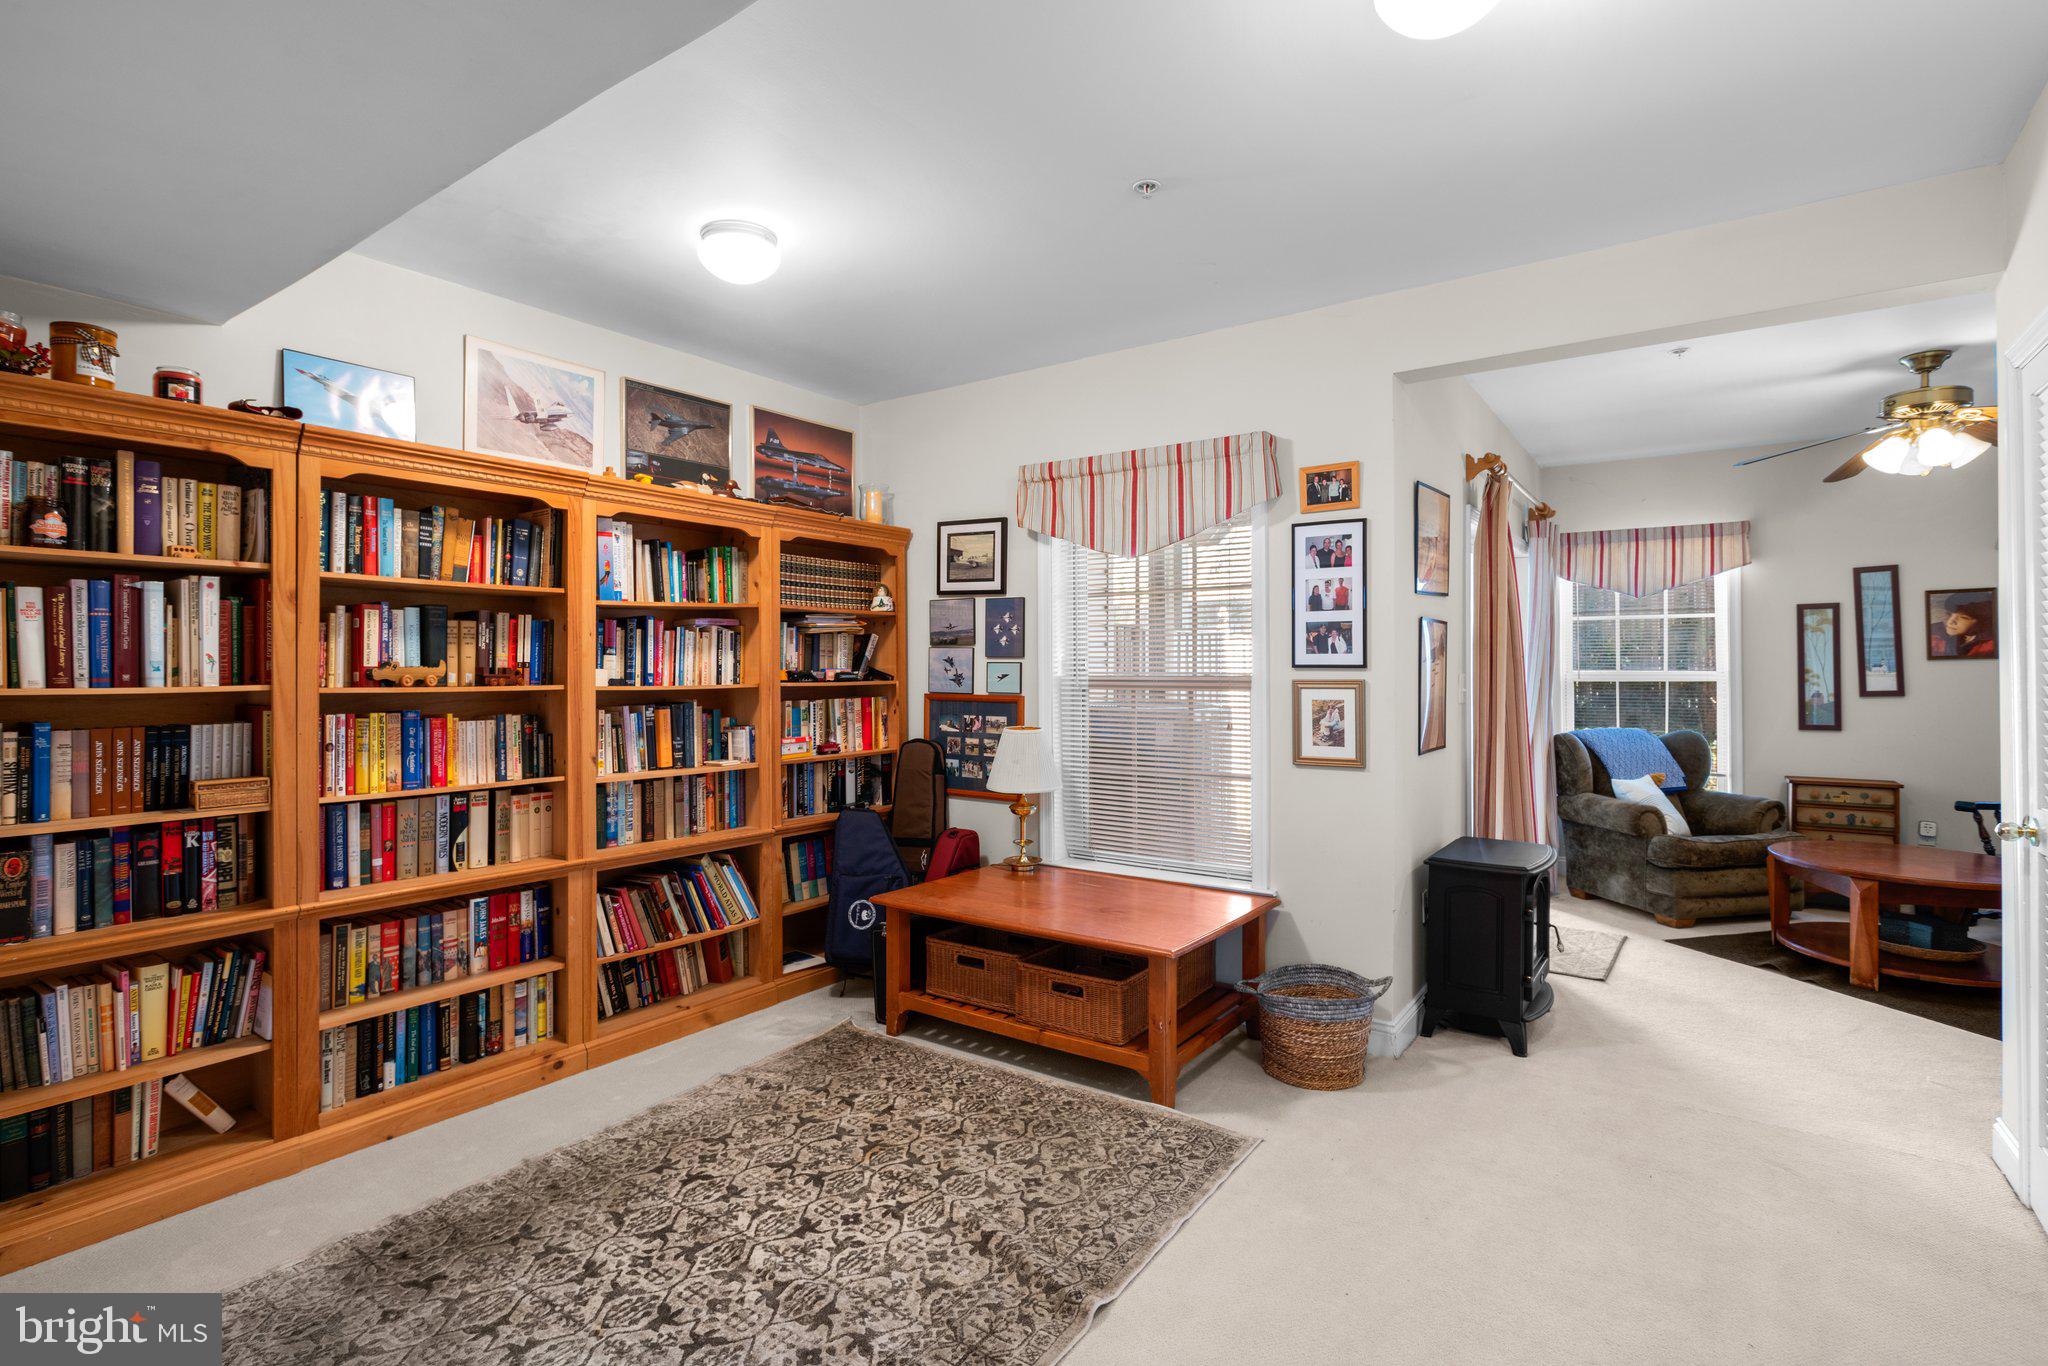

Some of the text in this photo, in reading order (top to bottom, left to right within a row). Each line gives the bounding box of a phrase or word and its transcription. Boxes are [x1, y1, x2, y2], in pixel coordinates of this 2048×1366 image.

[203, 502, 212, 514] THE
[203, 514, 212, 533] THIRD
[203, 535, 212, 551] WAVE
[77, 586, 85, 613] American
[100, 620, 108, 674] HUMAN HERITAGE
[4, 762, 17, 795] SPHINX
[337, 835, 344, 844] OF
[439, 812, 448, 859] MODERN TIMES
[712, 873, 738, 918] WORLD ATLAS
